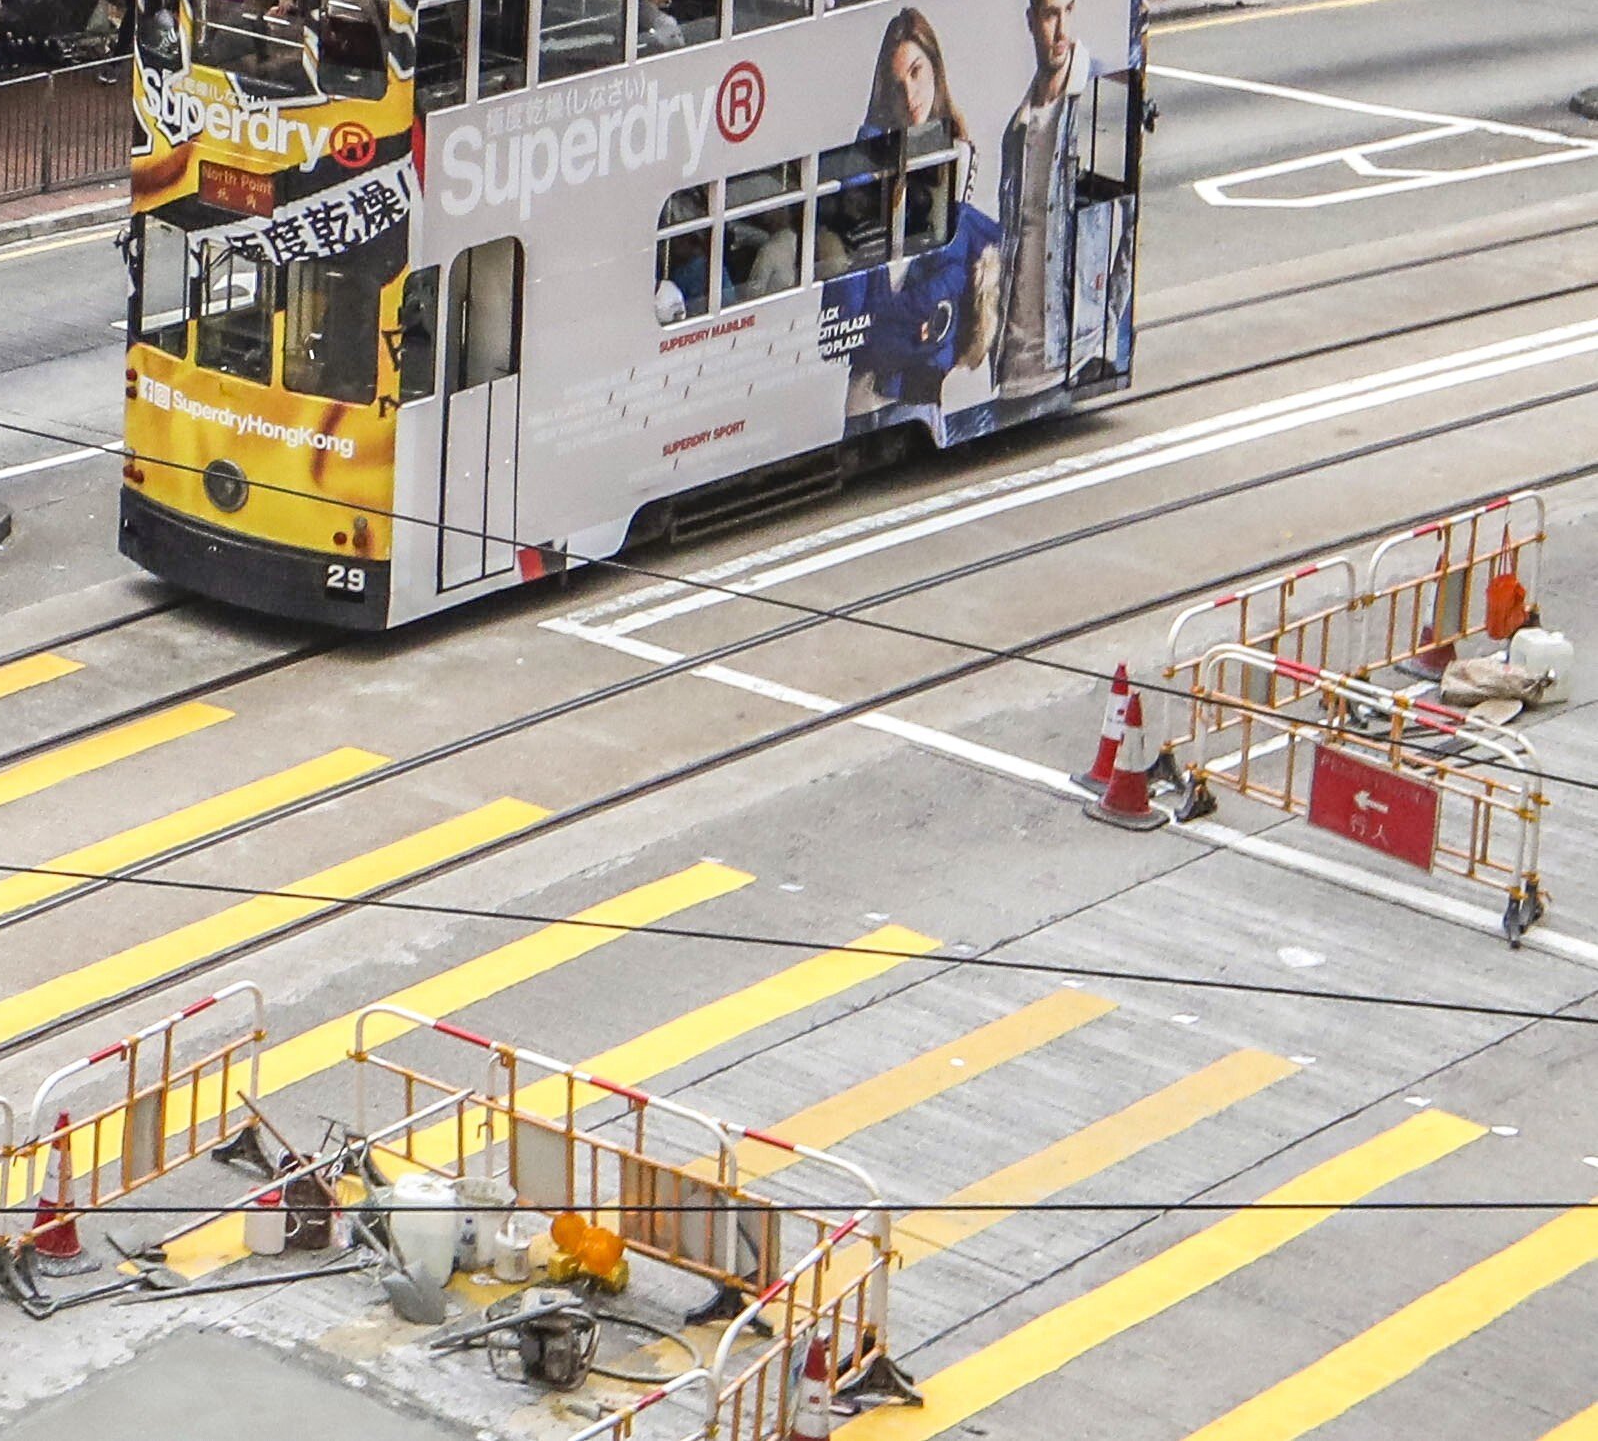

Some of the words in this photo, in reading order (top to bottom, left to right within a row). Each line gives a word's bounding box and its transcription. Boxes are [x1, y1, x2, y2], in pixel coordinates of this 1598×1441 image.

[141, 67, 332, 173] Superdry
[440, 79, 718, 221] Superdry
[202, 163, 238, 185] North
[240, 174, 273, 194] Point
[659, 326, 711, 354] SUPERDRY
[711, 314, 756, 338] MAINLINE
[840, 314, 872, 335] PLAZA
[833, 333, 866, 354] PLAZA
[172, 390, 355, 459] SuperdryHongKong
[662, 430, 712, 457] SUPERDRY
[713, 420, 746, 441] SPORT
[326, 564, 366, 593] 29
